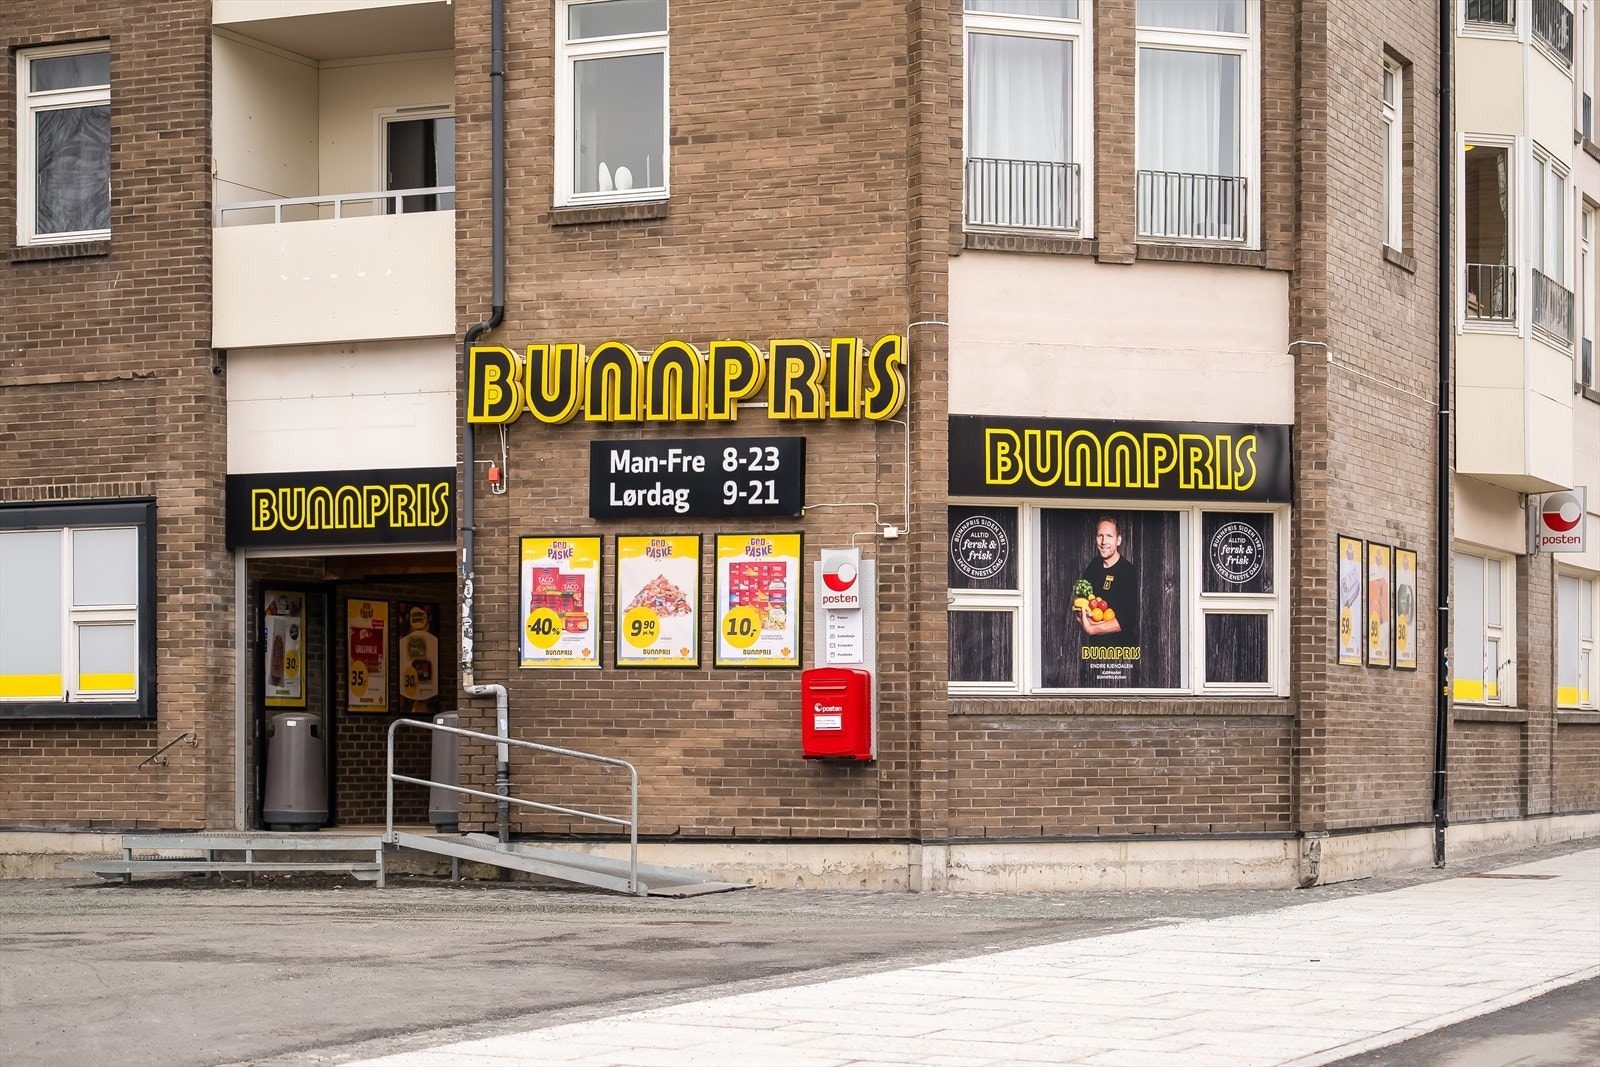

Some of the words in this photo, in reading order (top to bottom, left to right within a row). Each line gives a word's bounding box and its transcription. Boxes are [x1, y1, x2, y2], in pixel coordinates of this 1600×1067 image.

[467, 334, 908, 425] BUNNPRIS
[609, 448, 706, 474] Man-Fre
[722, 446, 780, 472] 8-23
[985, 427, 1257, 491] BUNNPRIS
[609, 481, 690, 513] Lørdag
[722, 479, 780, 505] 9-21
[251, 482, 449, 531] BUNNPRIS
[954, 519, 980, 543] BUNNPRIS
[981, 519, 1000, 533] SIDEN
[997, 531, 1006, 546] 1981
[1213, 524, 1237, 548] BUNNPRIS
[1238, 525, 1256, 538] SIDEN
[1542, 534, 1581, 546] posten
[962, 538, 988, 550] fersk
[988, 540, 997, 549] &
[1220, 544, 1245, 555] fersk
[1245, 545, 1254, 554] &
[967, 550, 992, 562] frisk
[1225, 555, 1249, 567] frisk
[957, 558, 971, 573] HVER
[971, 567, 993, 577] ENESTE
[992, 558, 1003, 571] DAG
[1215, 562, 1229, 577] HVER
[1229, 573, 1250, 581] ENESTE
[1248, 563, 1259, 575] DAG
[822, 594, 858, 605] posten
[527, 618, 560, 636] -40%
[727, 617, 757, 637] 10,-
[1081, 646, 1141, 660] BUNNPRIS
[822, 705, 843, 713] posten
